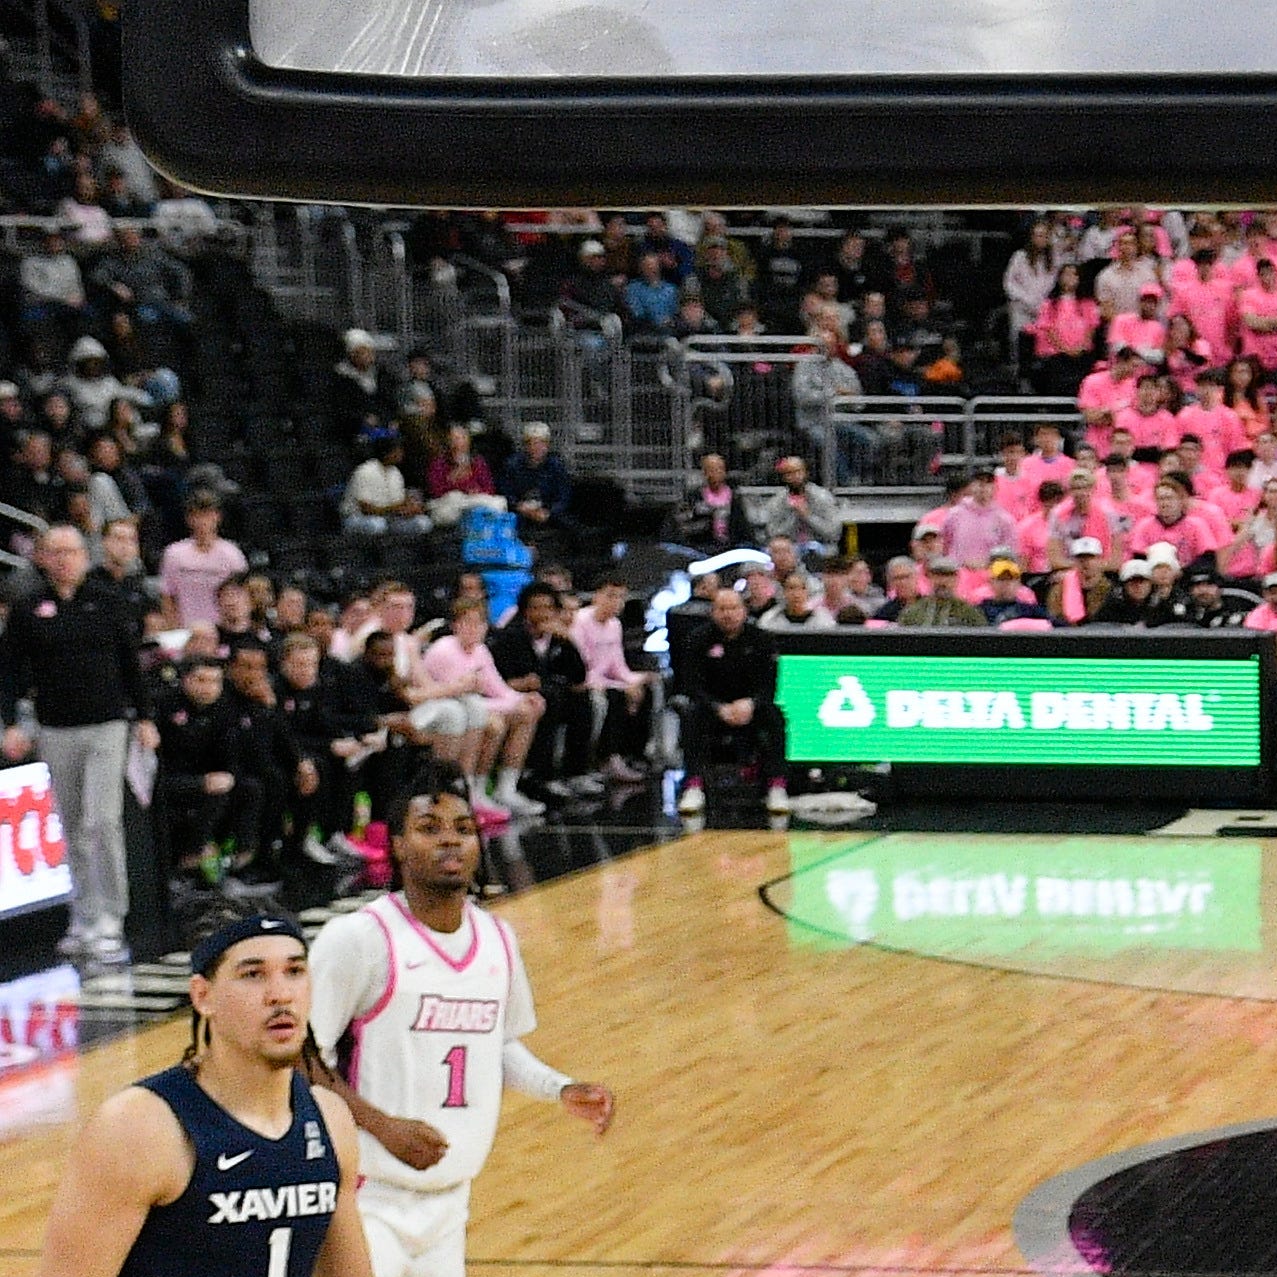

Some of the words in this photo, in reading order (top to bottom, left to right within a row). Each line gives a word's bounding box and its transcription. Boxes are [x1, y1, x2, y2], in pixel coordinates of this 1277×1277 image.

[886, 690, 1026, 730] DELTA
[1031, 692, 1214, 731] DENTAL
[411, 995, 499, 1032] FRIARS
[442, 1045, 468, 1108] 1
[207, 1181, 337, 1224] XAVIER
